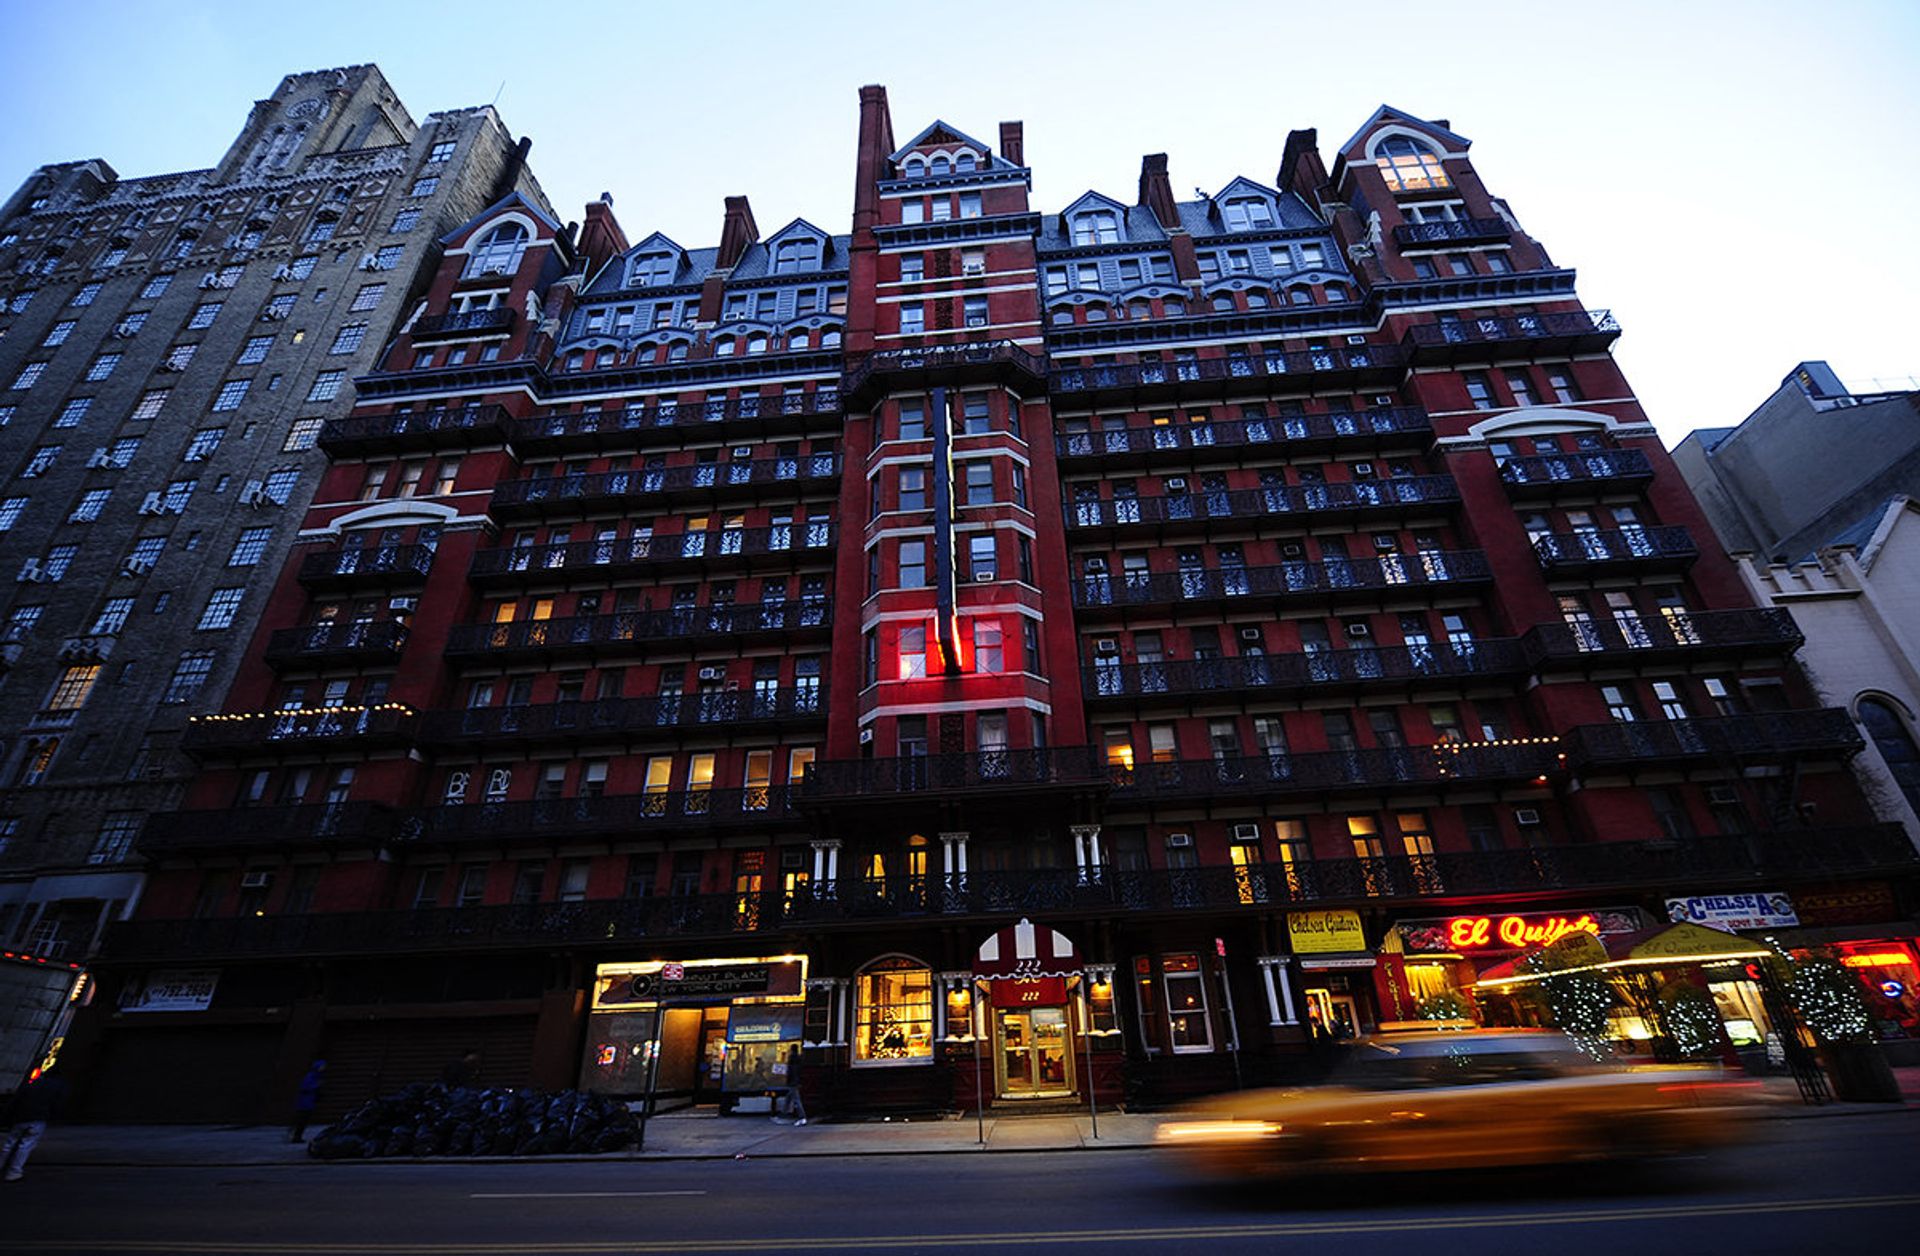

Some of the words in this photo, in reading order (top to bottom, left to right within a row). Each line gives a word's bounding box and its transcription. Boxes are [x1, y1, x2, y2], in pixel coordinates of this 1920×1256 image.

[1687, 894, 1775, 920] CHELSEA
[1451, 918, 1490, 946] El
[1015, 960, 1041, 973] 222
[1021, 991, 1040, 1001] 222
